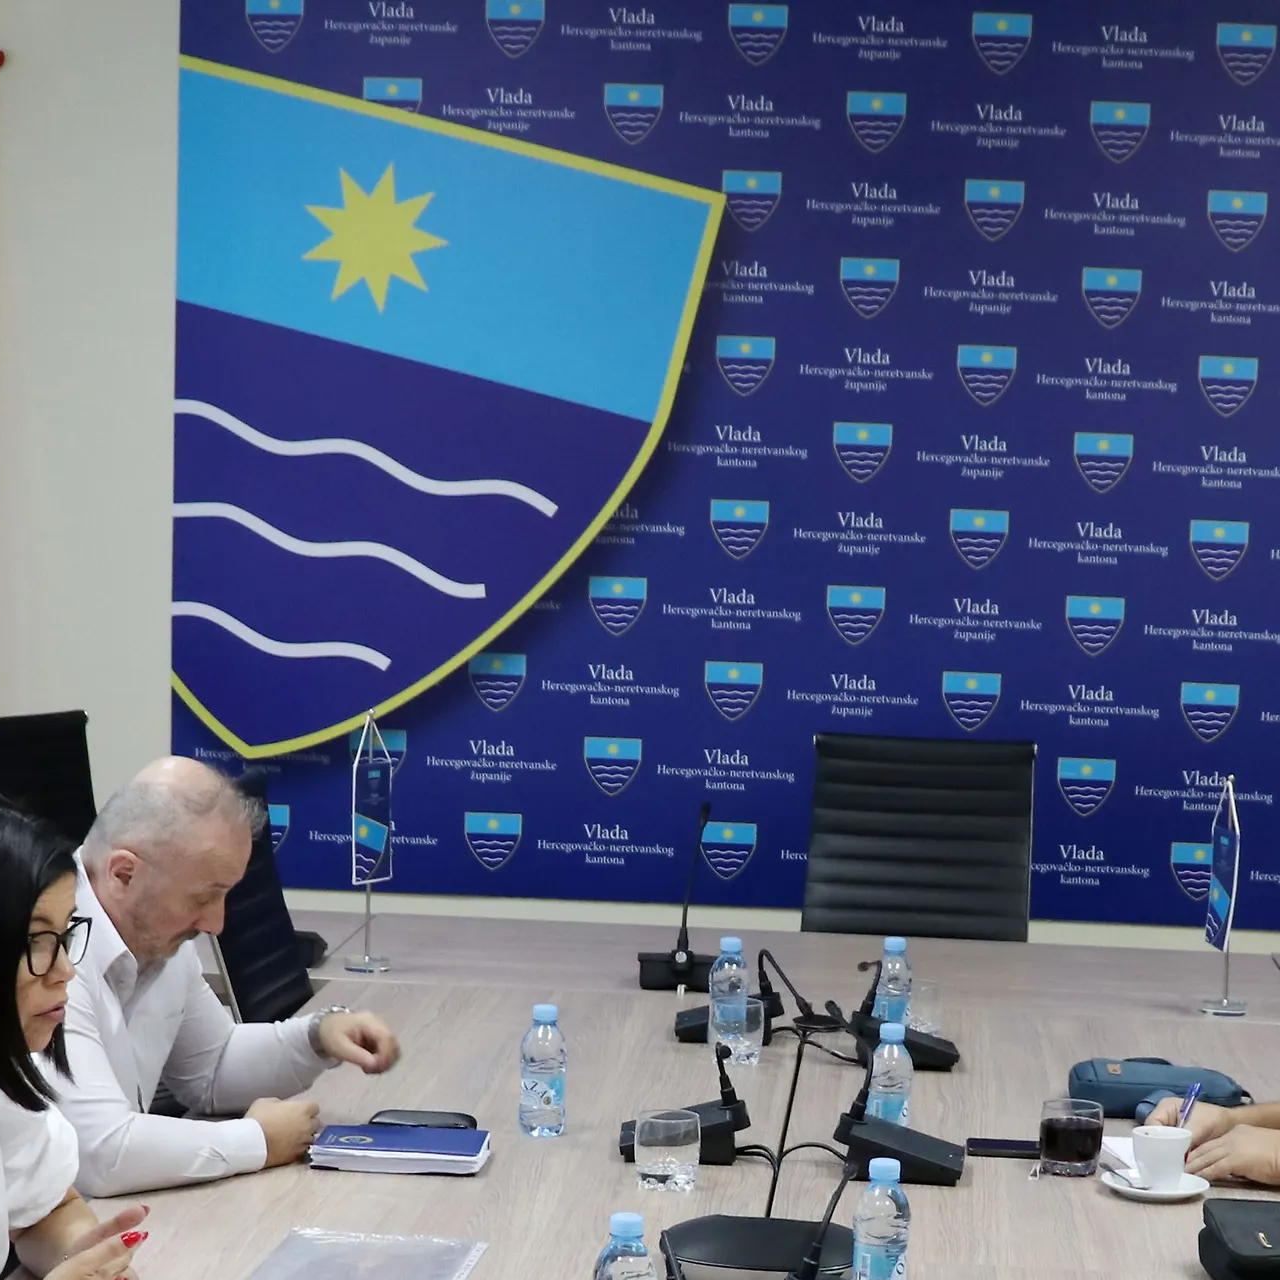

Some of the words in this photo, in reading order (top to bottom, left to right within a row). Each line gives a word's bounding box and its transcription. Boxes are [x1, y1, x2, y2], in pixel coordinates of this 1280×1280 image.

[369, 1, 414, 18] Vlada
[609, 7, 655, 24] Vlada
[858, 15, 904, 33] Vlada
[369, 34, 411, 47] županije
[1101, 25, 1147, 43] Vlada
[610, 39, 651, 51] kantona
[858, 48, 901, 61] županije
[1102, 56, 1143, 69] kantona
[486, 87, 532, 104] Vlada
[727, 94, 773, 112] Vlada
[976, 104, 1022, 121] Vlada
[487, 119, 530, 132] županije
[1219, 114, 1265, 132] Vlada
[729, 126, 769, 138] kantona
[976, 136, 1020, 149] županije
[1219, 146, 1260, 159] kantona
[851, 182, 897, 199] Vlada
[1093, 192, 1139, 210] Vlada
[852, 214, 894, 228] županije
[1094, 223, 1135, 236] kantona
[723, 261, 767, 278] Vlada
[969, 270, 1014, 287] Vlada
[1210, 281, 1255, 298] Vlada
[723, 293, 763, 304] kantona
[969, 302, 1012, 315] županije
[1210, 312, 1251, 325] kantona
[844, 348, 890, 365] Vlada
[1085, 358, 1130, 375] Vlada
[844, 379, 887, 393] županije
[1086, 388, 1126, 401] kantona
[715, 425, 761, 442] Vlada
[961, 435, 1007, 452] Vlada
[717, 456, 757, 468] kantona
[1201, 446, 1246, 463] Vlada
[961, 466, 1004, 480] županije
[1201, 476, 1242, 489] kantona
[838, 512, 883, 528] Vlada
[1077, 522, 1122, 539] Vlada
[838, 543, 880, 556] županije
[1077, 552, 1118, 565] kantona
[710, 588, 755, 604] Vlada
[954, 598, 999, 615] Vlada
[711, 618, 751, 630] kantona
[1192, 609, 1237, 626] Vlada
[954, 629, 996, 642] županije
[1192, 639, 1233, 652] kantona
[588, 664, 633, 680] Vlada
[831, 674, 876, 691] Vlada
[590, 694, 630, 706] kantona
[1068, 684, 1113, 701] Vlada
[831, 705, 873, 718] županije
[1069, 714, 1109, 727] kantona
[469, 740, 514, 756] Vlada
[704, 749, 749, 766] Vlada
[470, 771, 512, 783] županije
[705, 779, 745, 791] kantona
[1183, 770, 1227, 787] Vlada
[584, 824, 628, 840] Vlada
[585, 853, 625, 865] kantona
[1060, 844, 1104, 861] Vlada
[1031, 861, 1150, 879] cegovačko-neretvanskog
[1060, 874, 1100, 886] kantona
